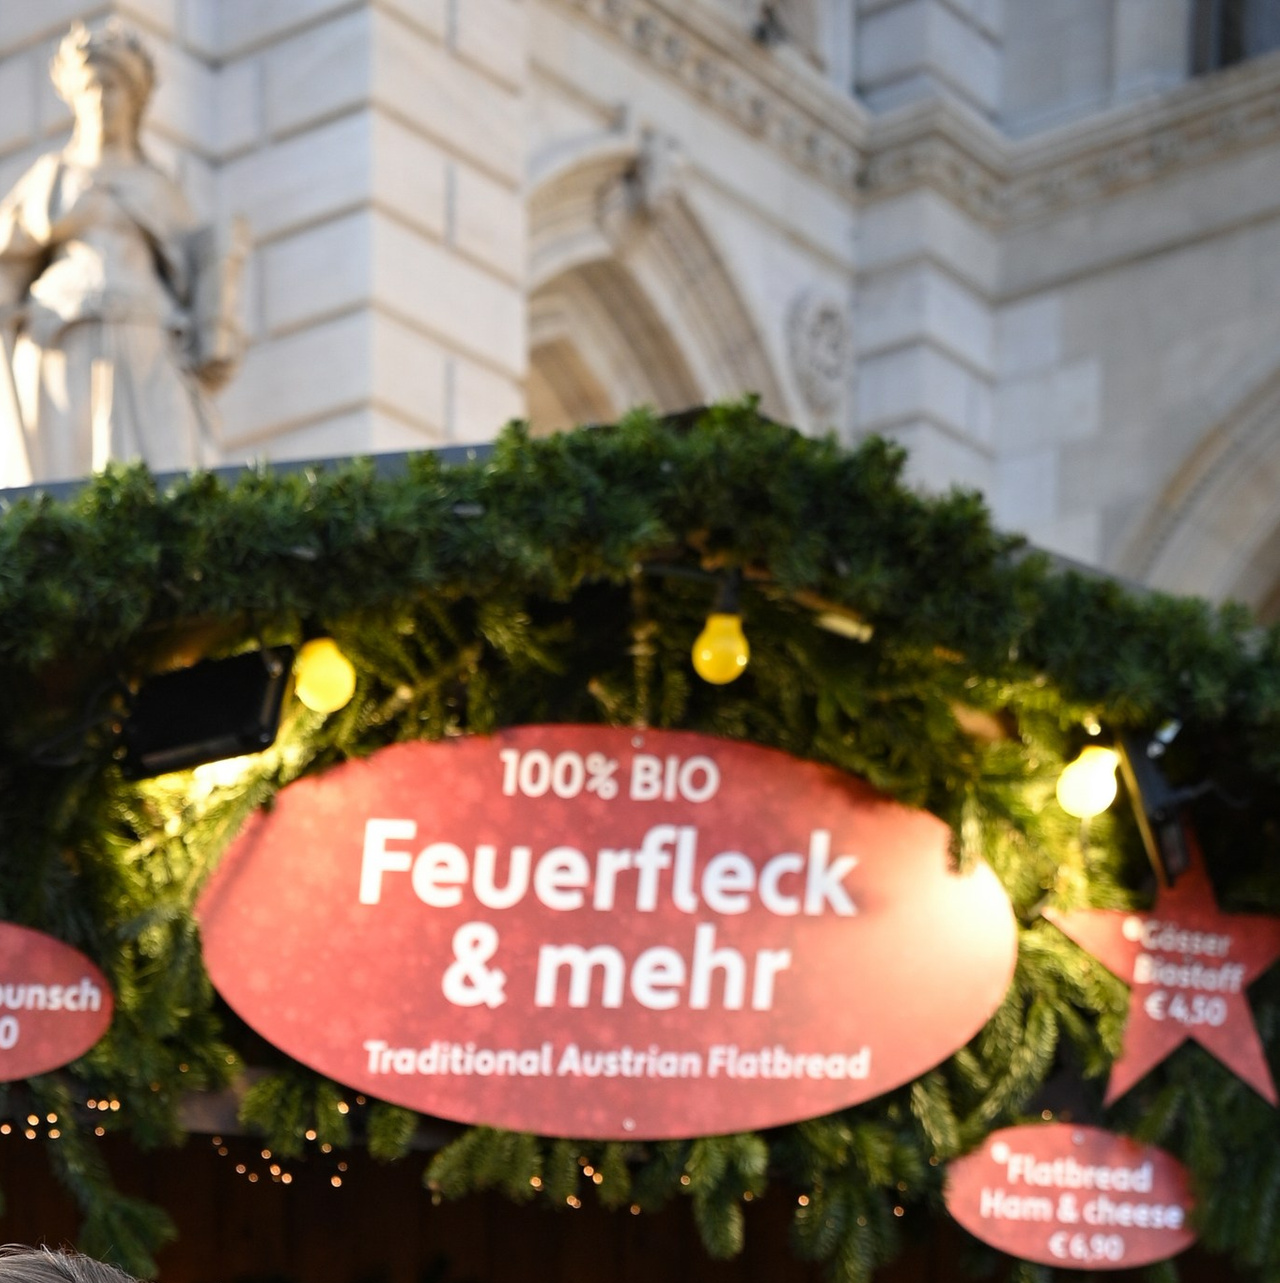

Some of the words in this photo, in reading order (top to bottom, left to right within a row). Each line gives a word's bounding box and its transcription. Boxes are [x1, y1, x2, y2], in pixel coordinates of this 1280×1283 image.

[500, 749, 619, 800] 100%
[630, 754, 720, 802] BIO
[359, 818, 861, 917] Feuerfleck
[441, 921, 508, 1009] &
[535, 922, 793, 1012] mehr
[1144, 990, 1168, 1021] €
[362, 1040, 553, 1077] Traditional
[556, 1043, 703, 1079] Austrian
[708, 1045, 871, 1081] Flatbread
[1006, 1153, 1154, 1194] Flatbread
[979, 1186, 1053, 1222] Ham
[1056, 1192, 1080, 1224] &
[1082, 1195, 1186, 1230] cheese
[1048, 1231, 1069, 1259] €
